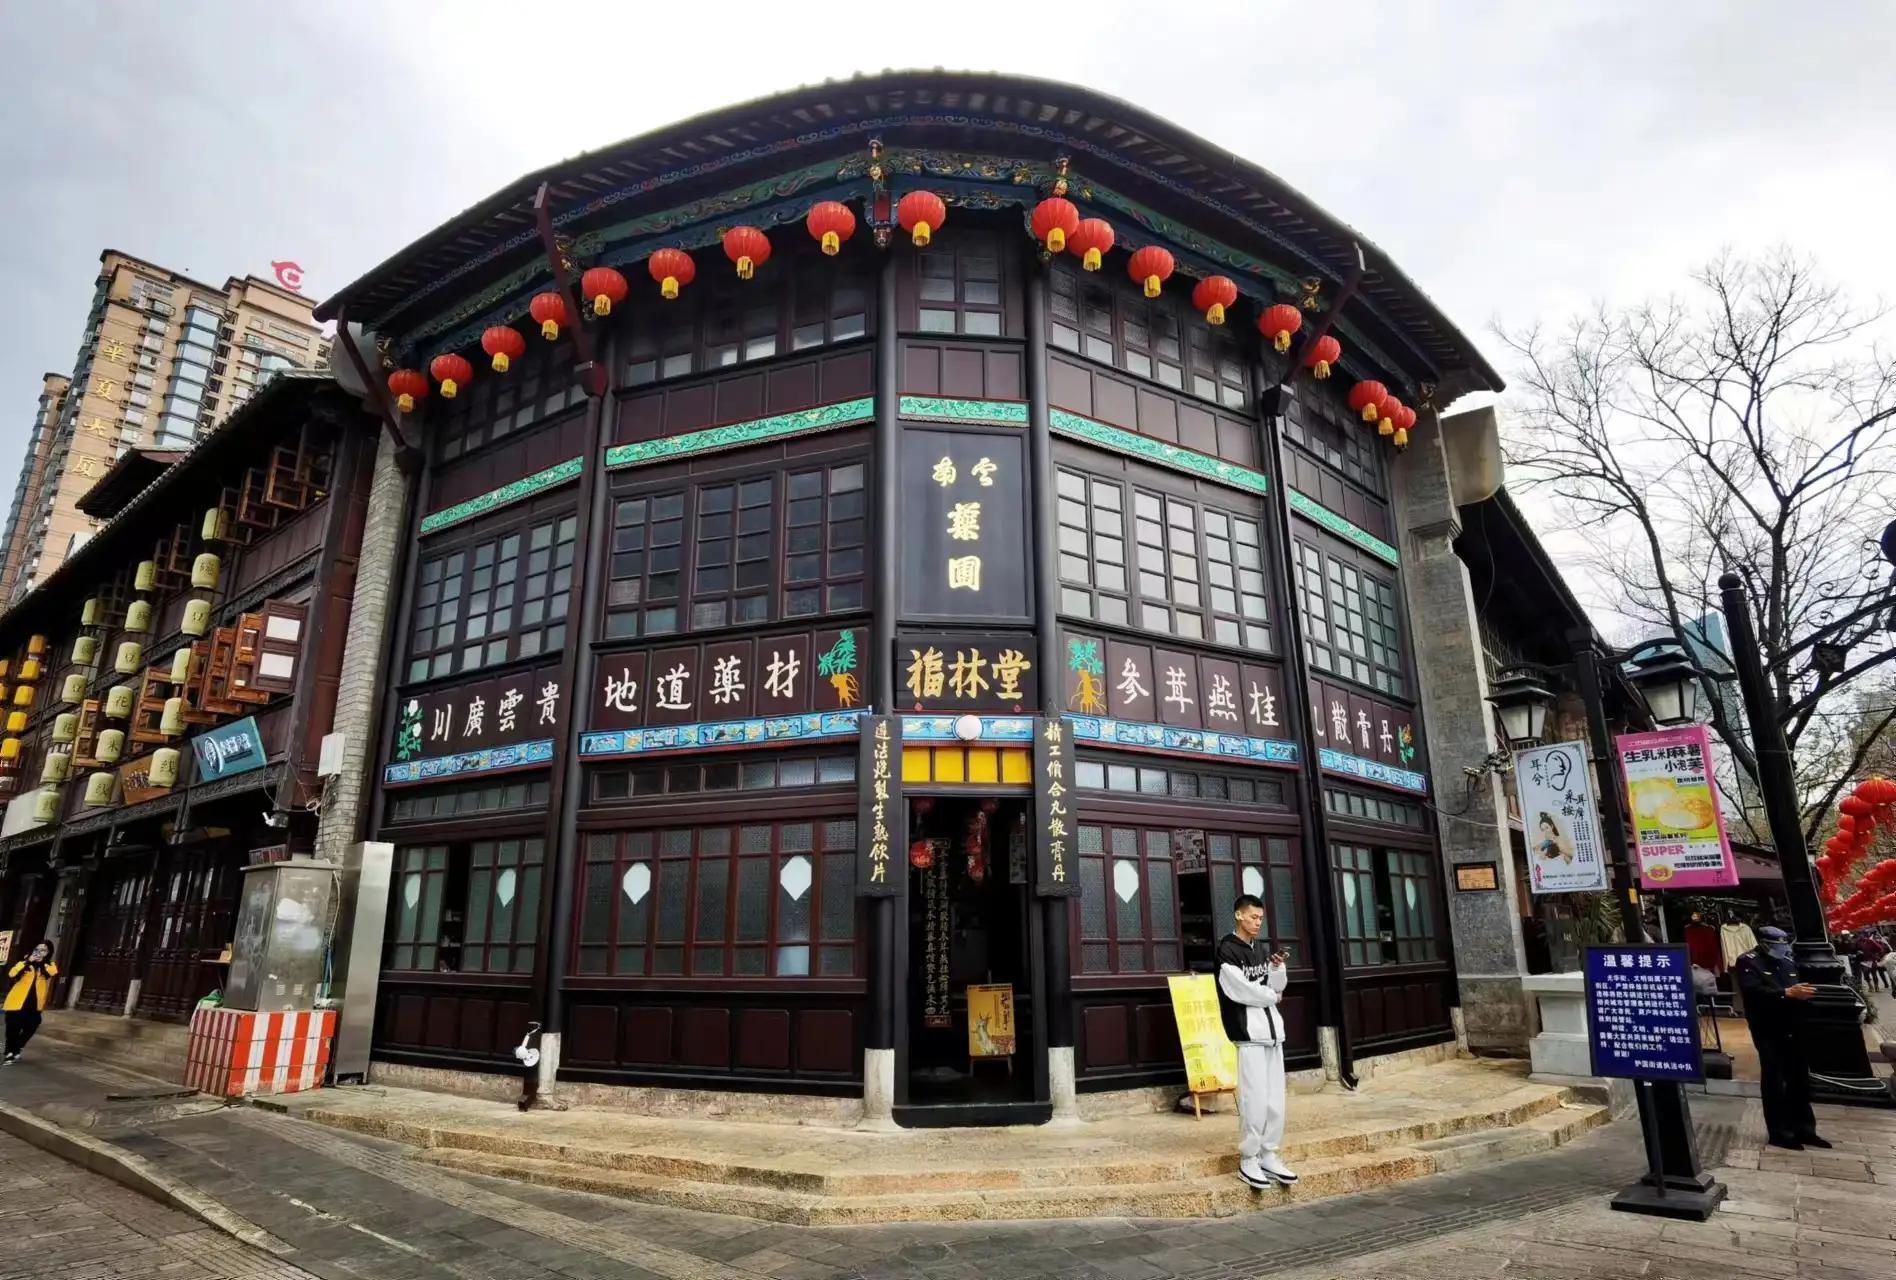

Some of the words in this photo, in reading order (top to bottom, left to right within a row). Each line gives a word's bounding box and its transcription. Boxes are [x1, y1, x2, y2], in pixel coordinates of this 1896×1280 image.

[906, 646, 1032, 700] 福林堂
[1313, 700, 1393, 754] 散膏丹
[1642, 845, 1685, 857] SUPER
[1603, 954, 1671, 968] 温馨提示
